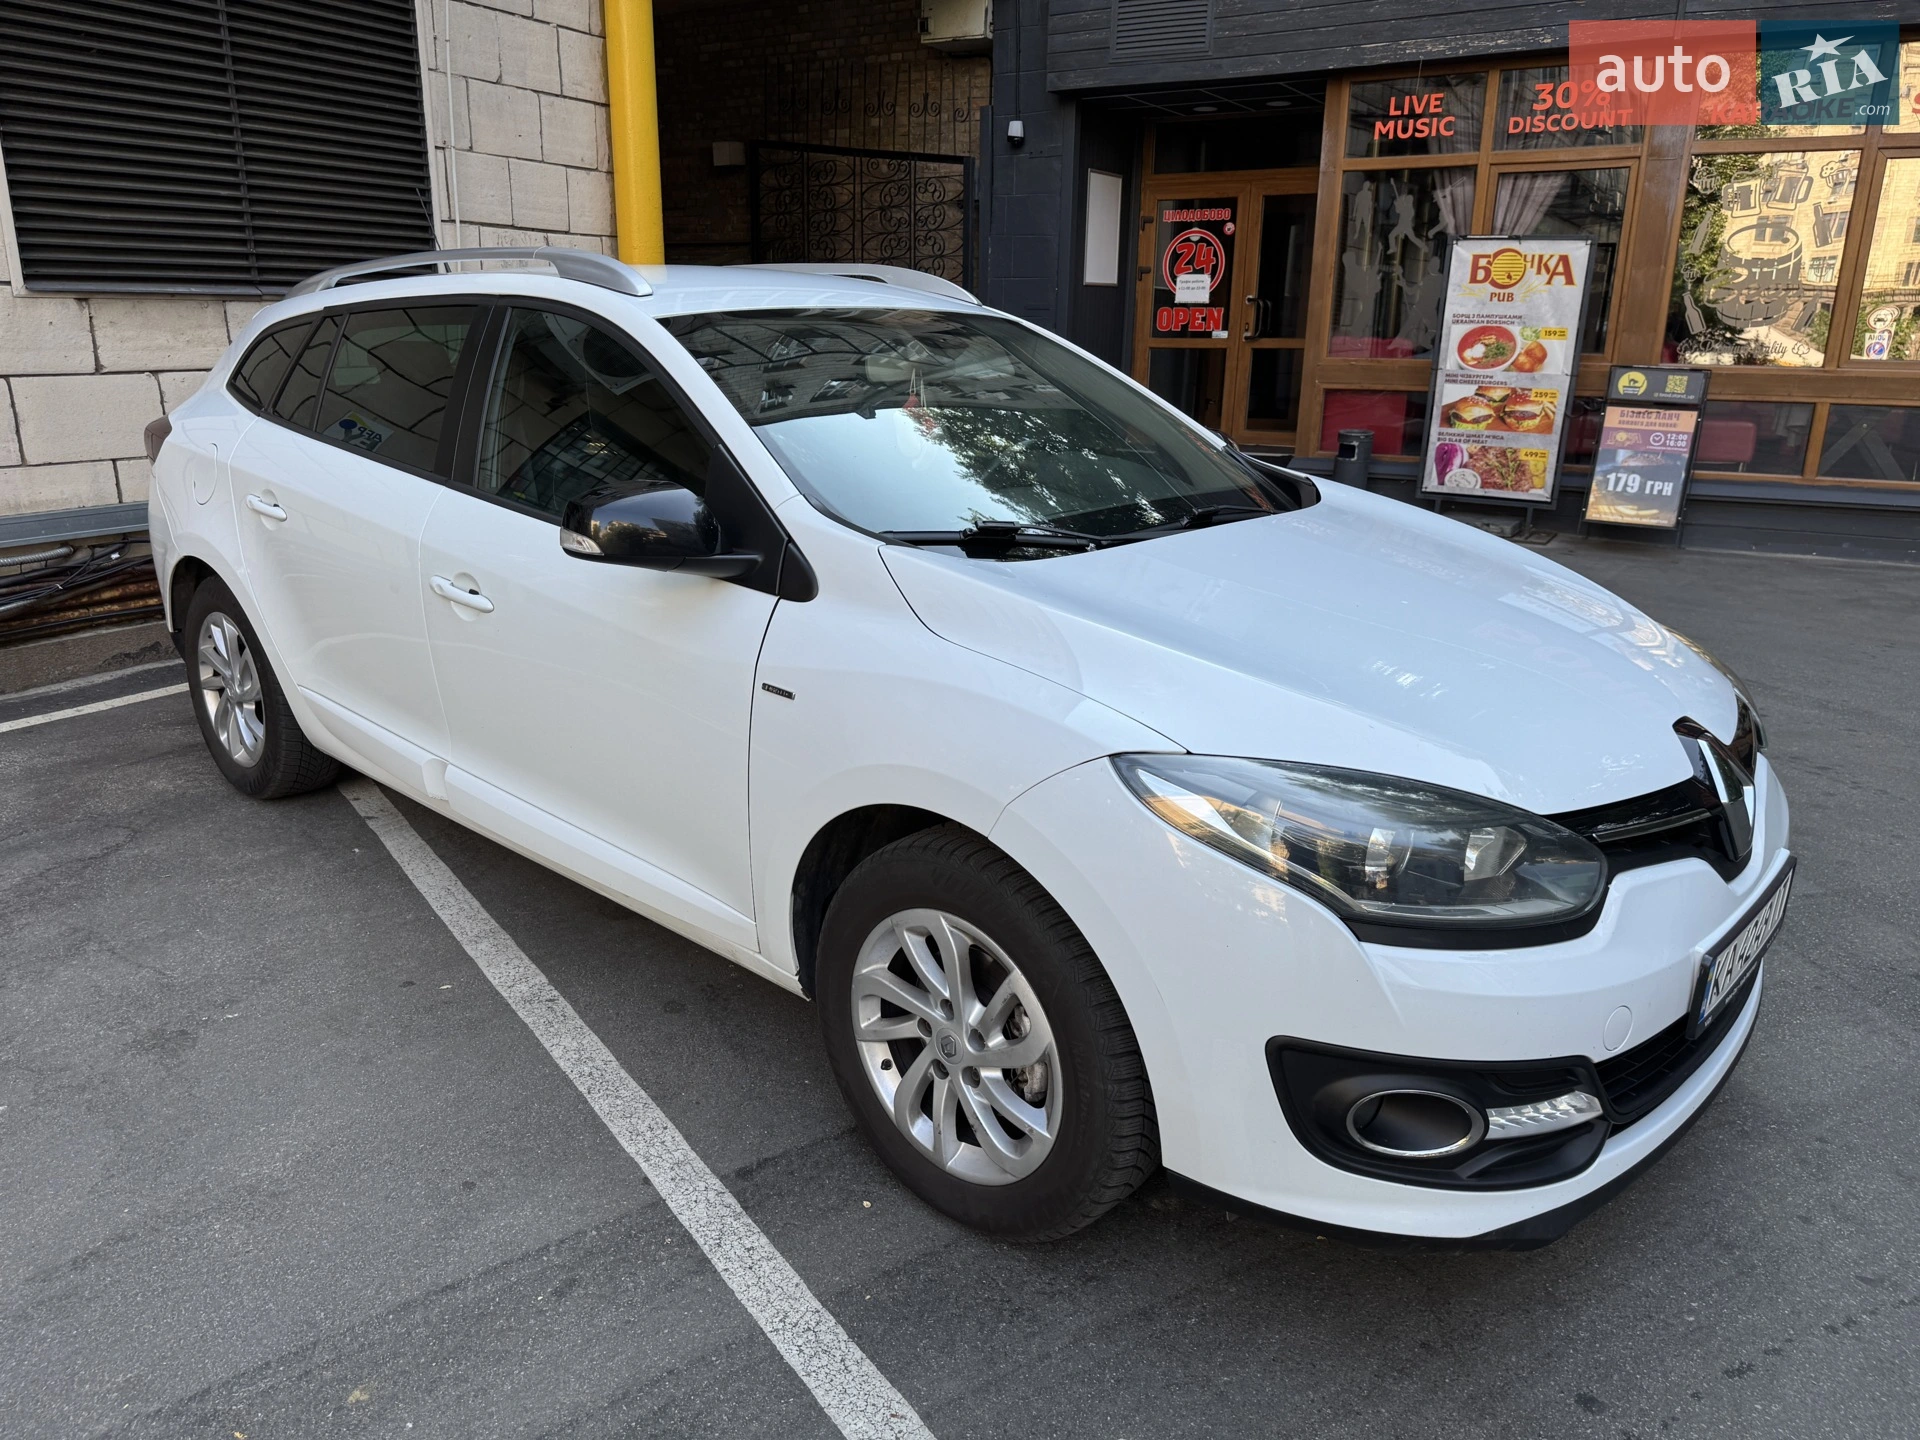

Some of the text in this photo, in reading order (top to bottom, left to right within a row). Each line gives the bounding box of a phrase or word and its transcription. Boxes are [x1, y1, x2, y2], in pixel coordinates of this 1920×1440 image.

[1388, 92, 1444, 116] LIVE
[1532, 80, 1611, 111] 30%
[1508, 109, 1633, 134] DISCOUNT
[1709, 97, 1855, 124] KARAOKE
[1374, 116, 1456, 140] MUSIC
[1163, 208, 1231, 222] ЦІЛОДОБОВО
[1174, 242, 1216, 276] 24
[1468, 247, 1577, 290] БОЧКА
[1489, 291, 1515, 303] PUB
[1156, 306, 1224, 332] OPEN
[1619, 409, 1681, 421] БІЗНЕС ЛАНЧ
[1665, 440, 1687, 448] 16:00
[1667, 433, 1688, 441] 12:00
[1606, 472, 1674, 496] 179 ГРН
